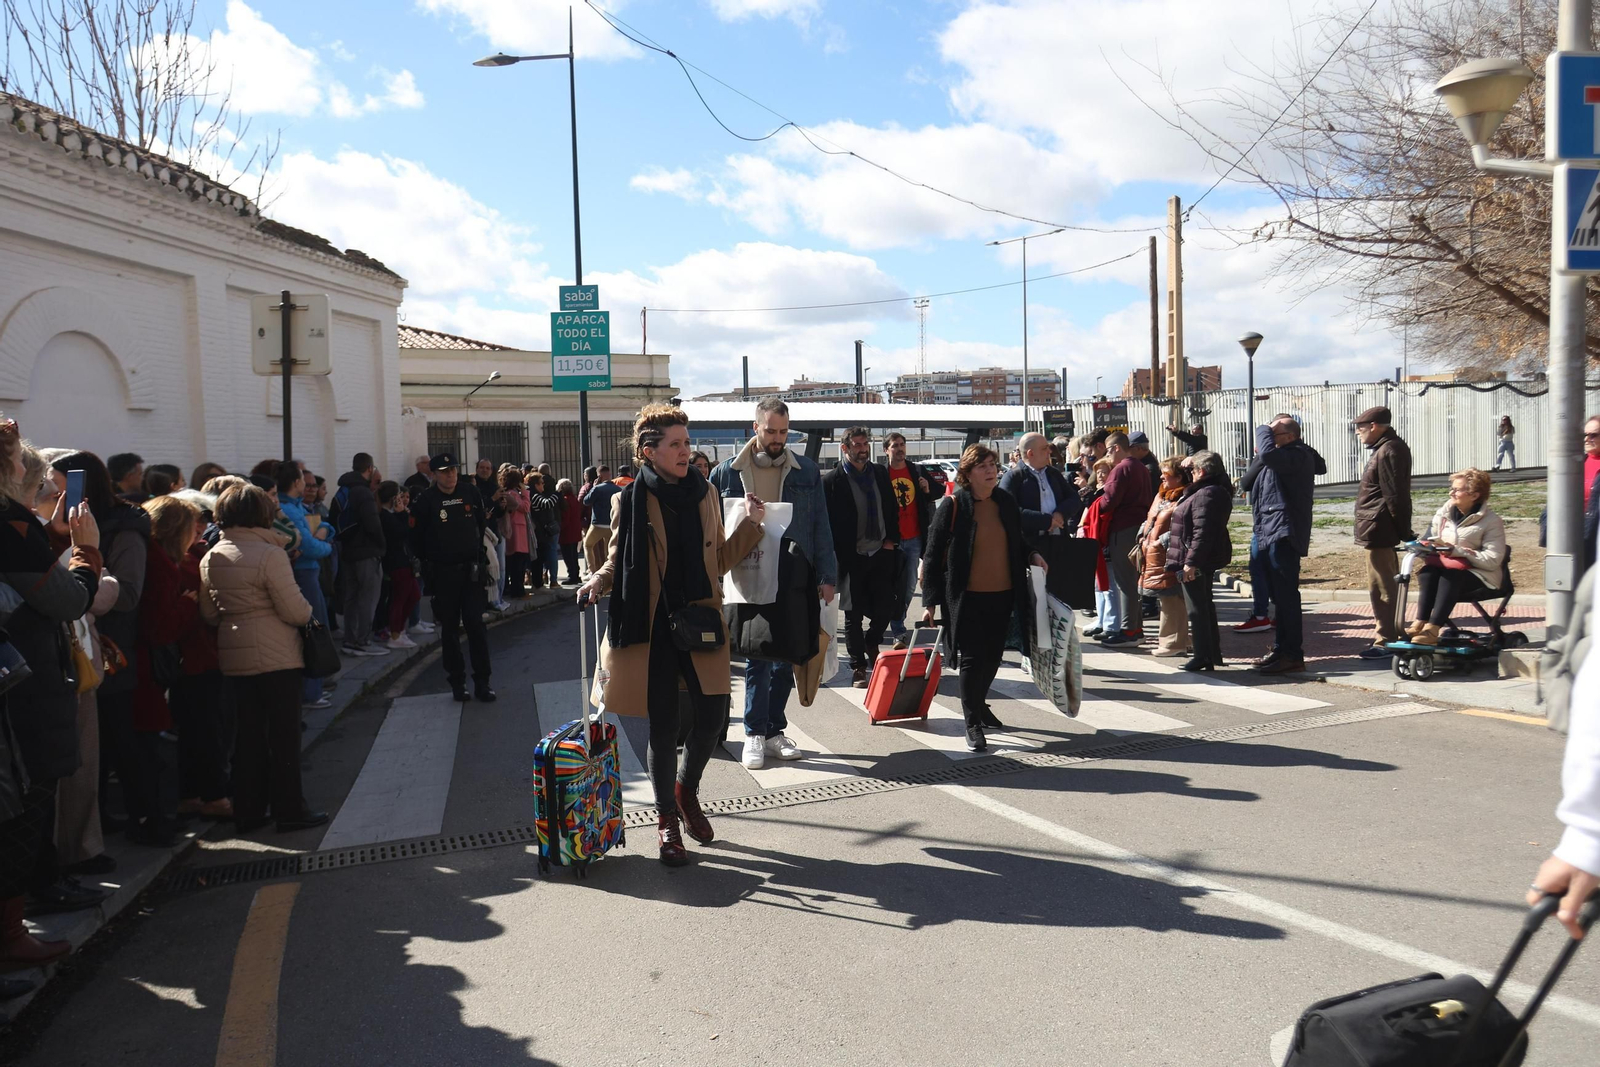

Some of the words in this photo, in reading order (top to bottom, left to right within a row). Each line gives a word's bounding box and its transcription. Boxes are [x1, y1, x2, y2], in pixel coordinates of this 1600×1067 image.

[556, 315, 606, 325] APARCA
[557, 328, 587, 338] TODO
[590, 328, 606, 337] EL
[571, 340, 592, 351] DÍA
[557, 358, 594, 373] 11,50
[595, 358, 605, 371] €
